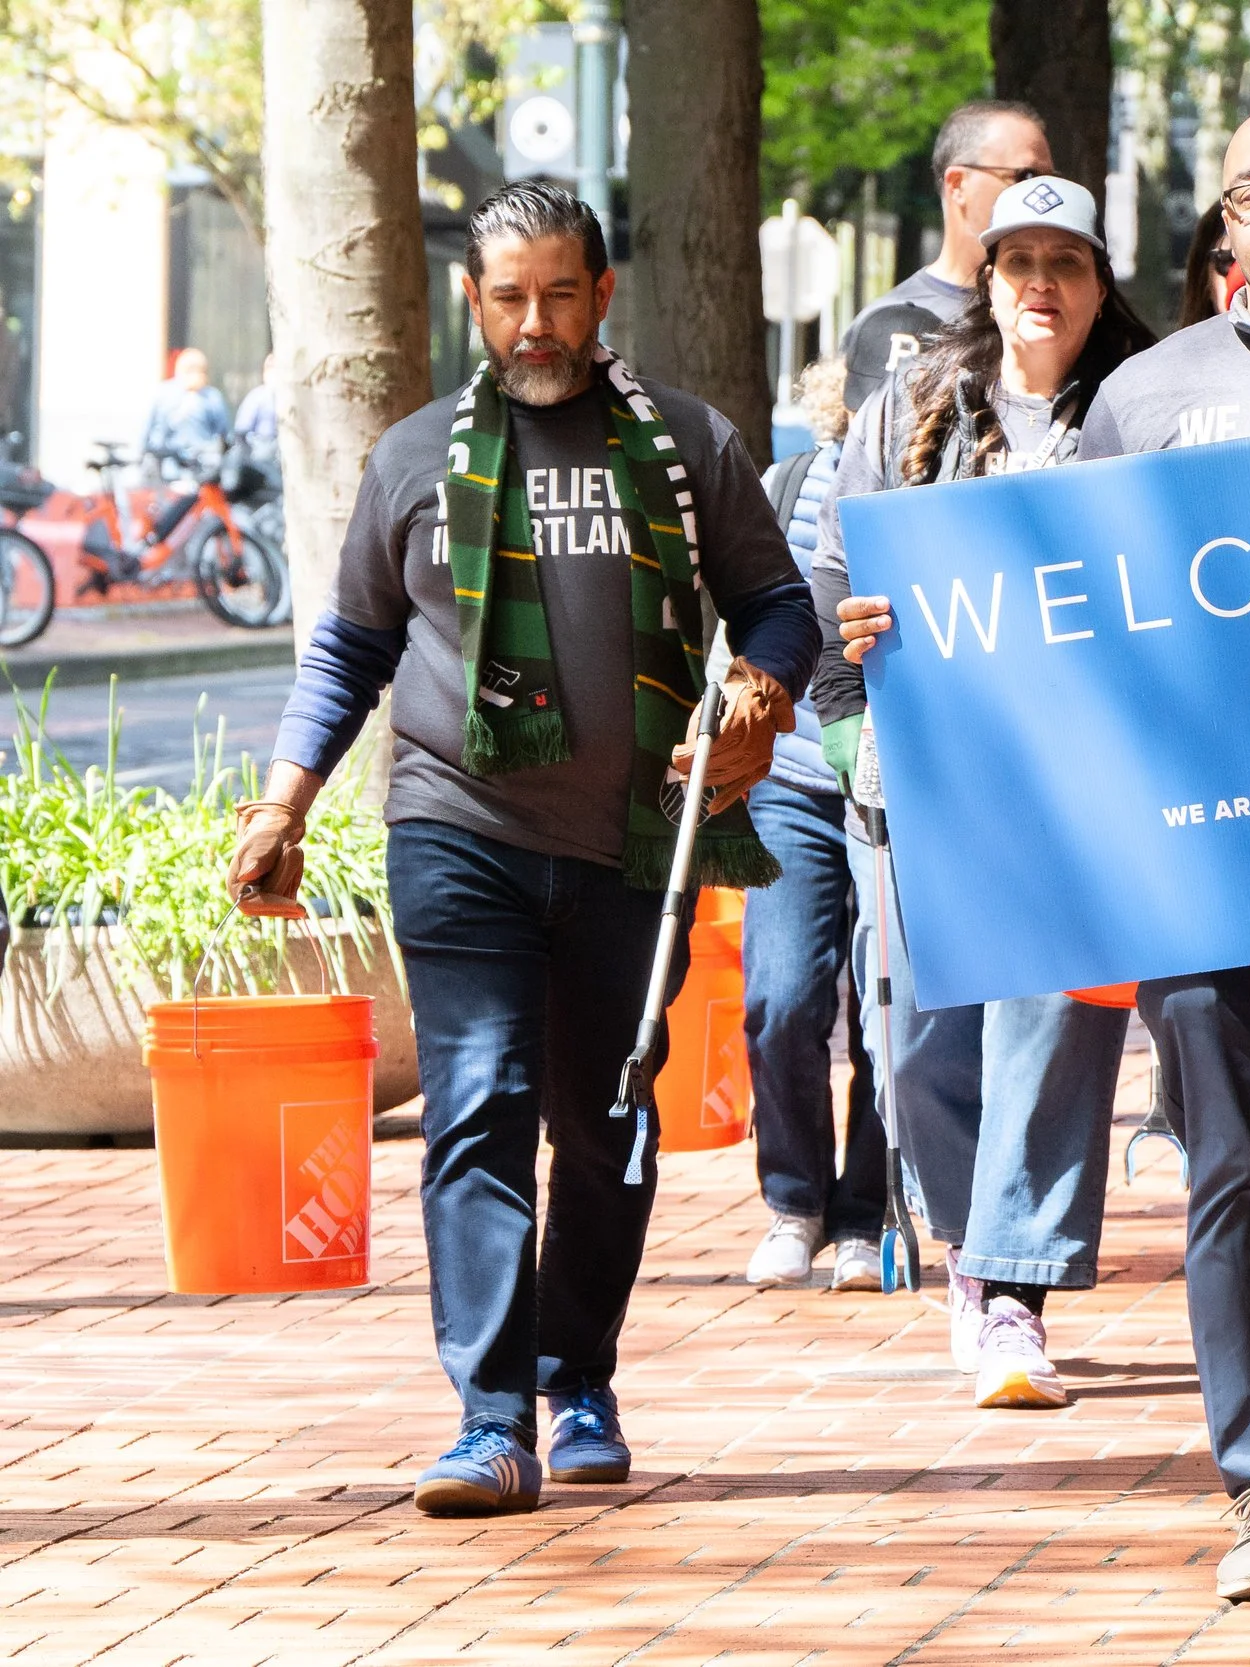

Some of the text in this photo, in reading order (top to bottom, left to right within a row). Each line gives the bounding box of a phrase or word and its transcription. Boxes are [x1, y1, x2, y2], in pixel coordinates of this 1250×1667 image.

[526, 467, 622, 511] ELIEV
[529, 514, 632, 556] RTLAN
[1161, 803, 1206, 828] WE
